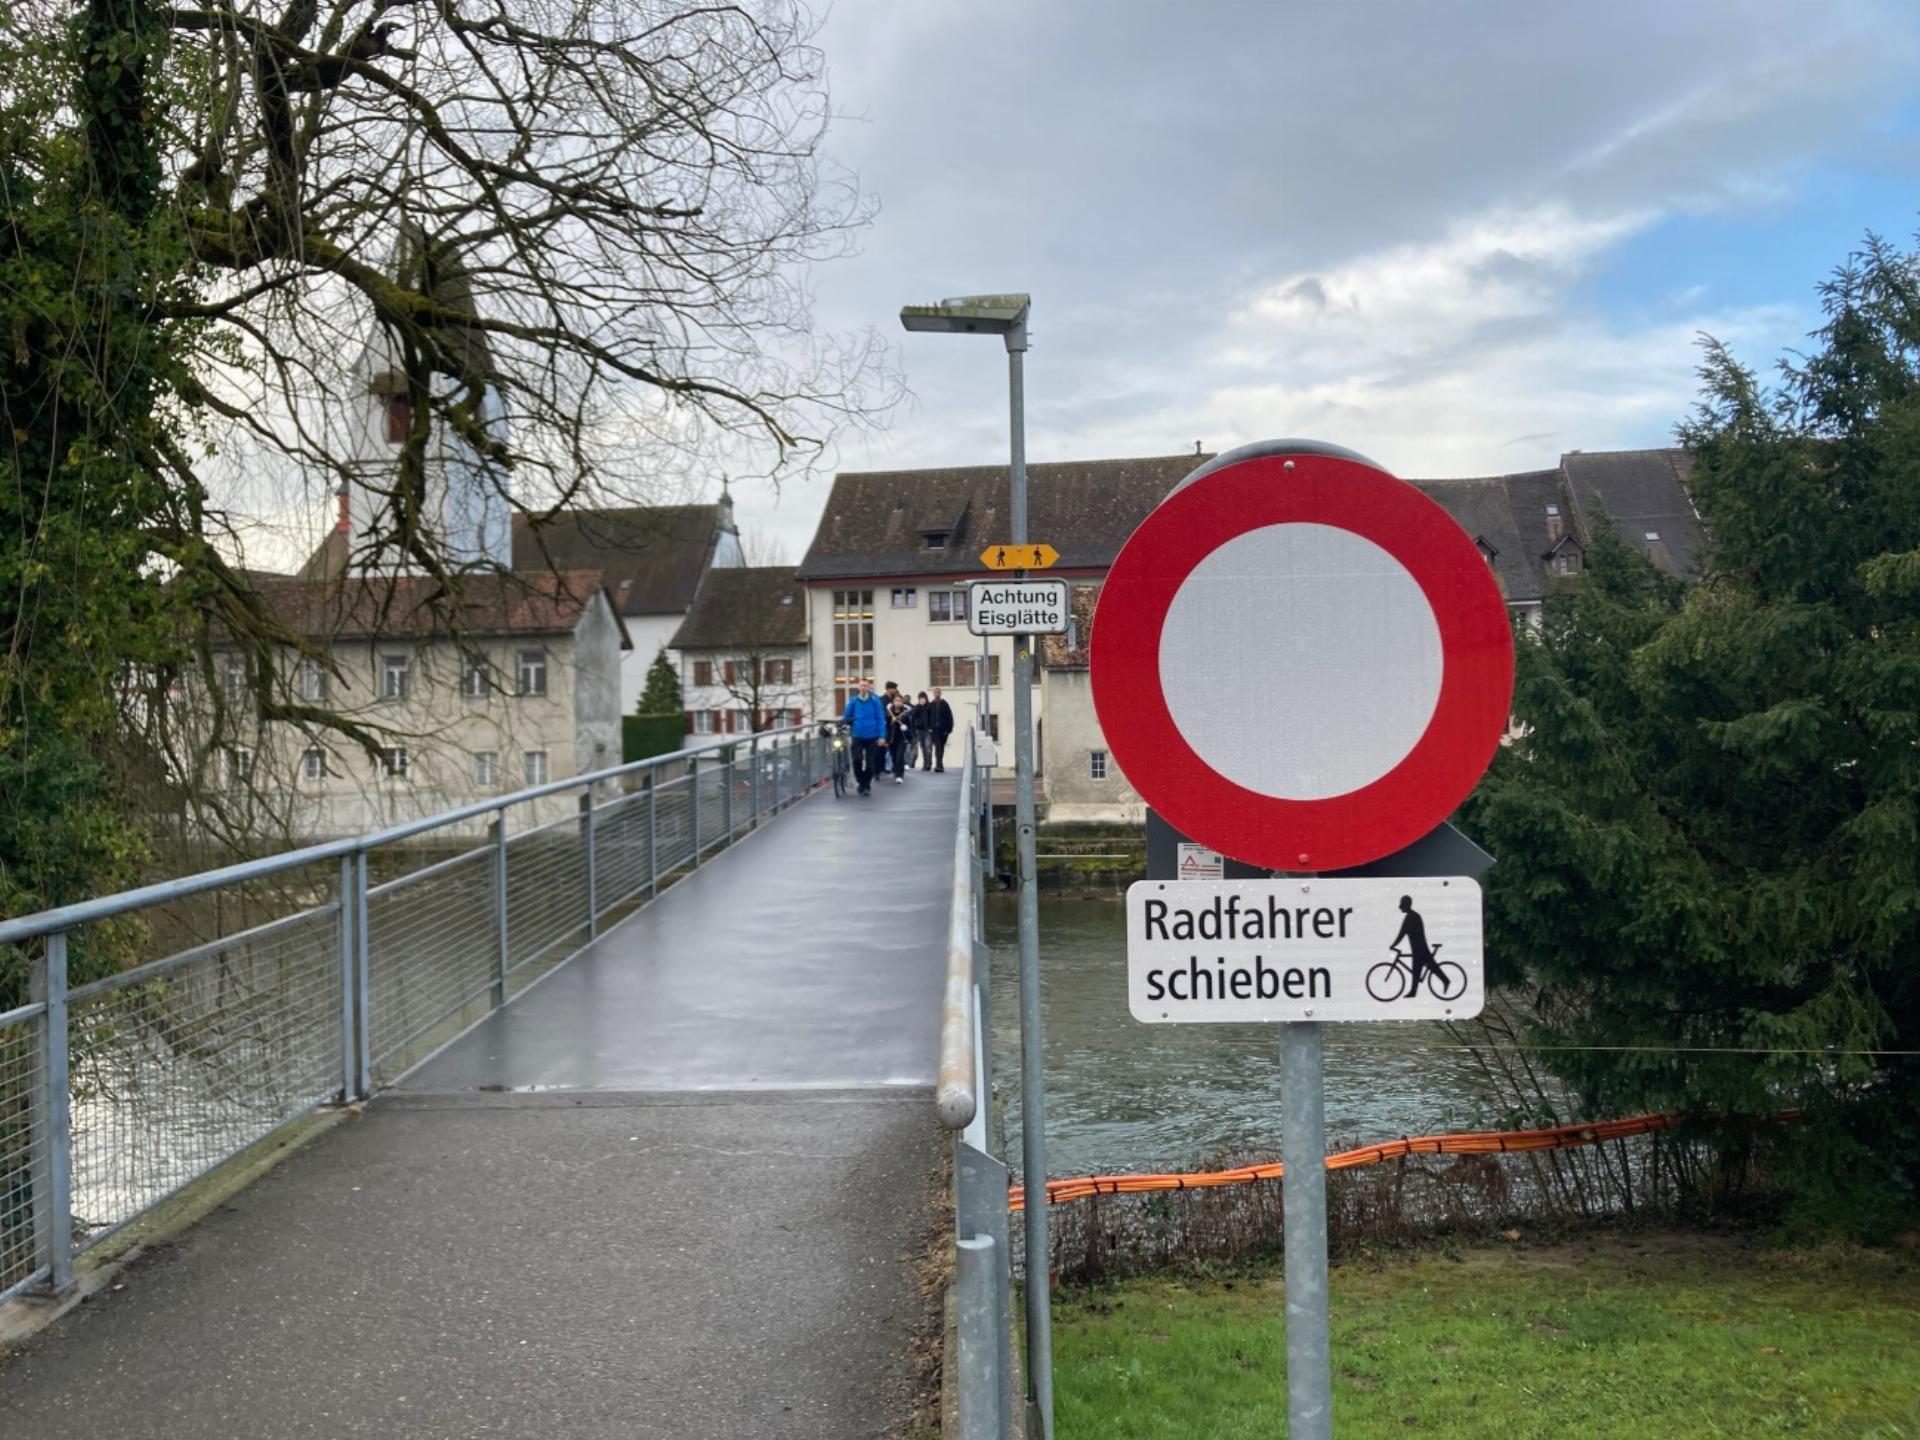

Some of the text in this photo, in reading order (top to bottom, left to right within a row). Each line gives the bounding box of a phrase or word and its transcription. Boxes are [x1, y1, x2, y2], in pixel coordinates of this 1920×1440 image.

[981, 590, 1057, 606] Achtung
[979, 610, 1058, 627] Eisglätte
[1144, 895, 1353, 940] Radfahrer
[1146, 955, 1332, 1000] schieben
